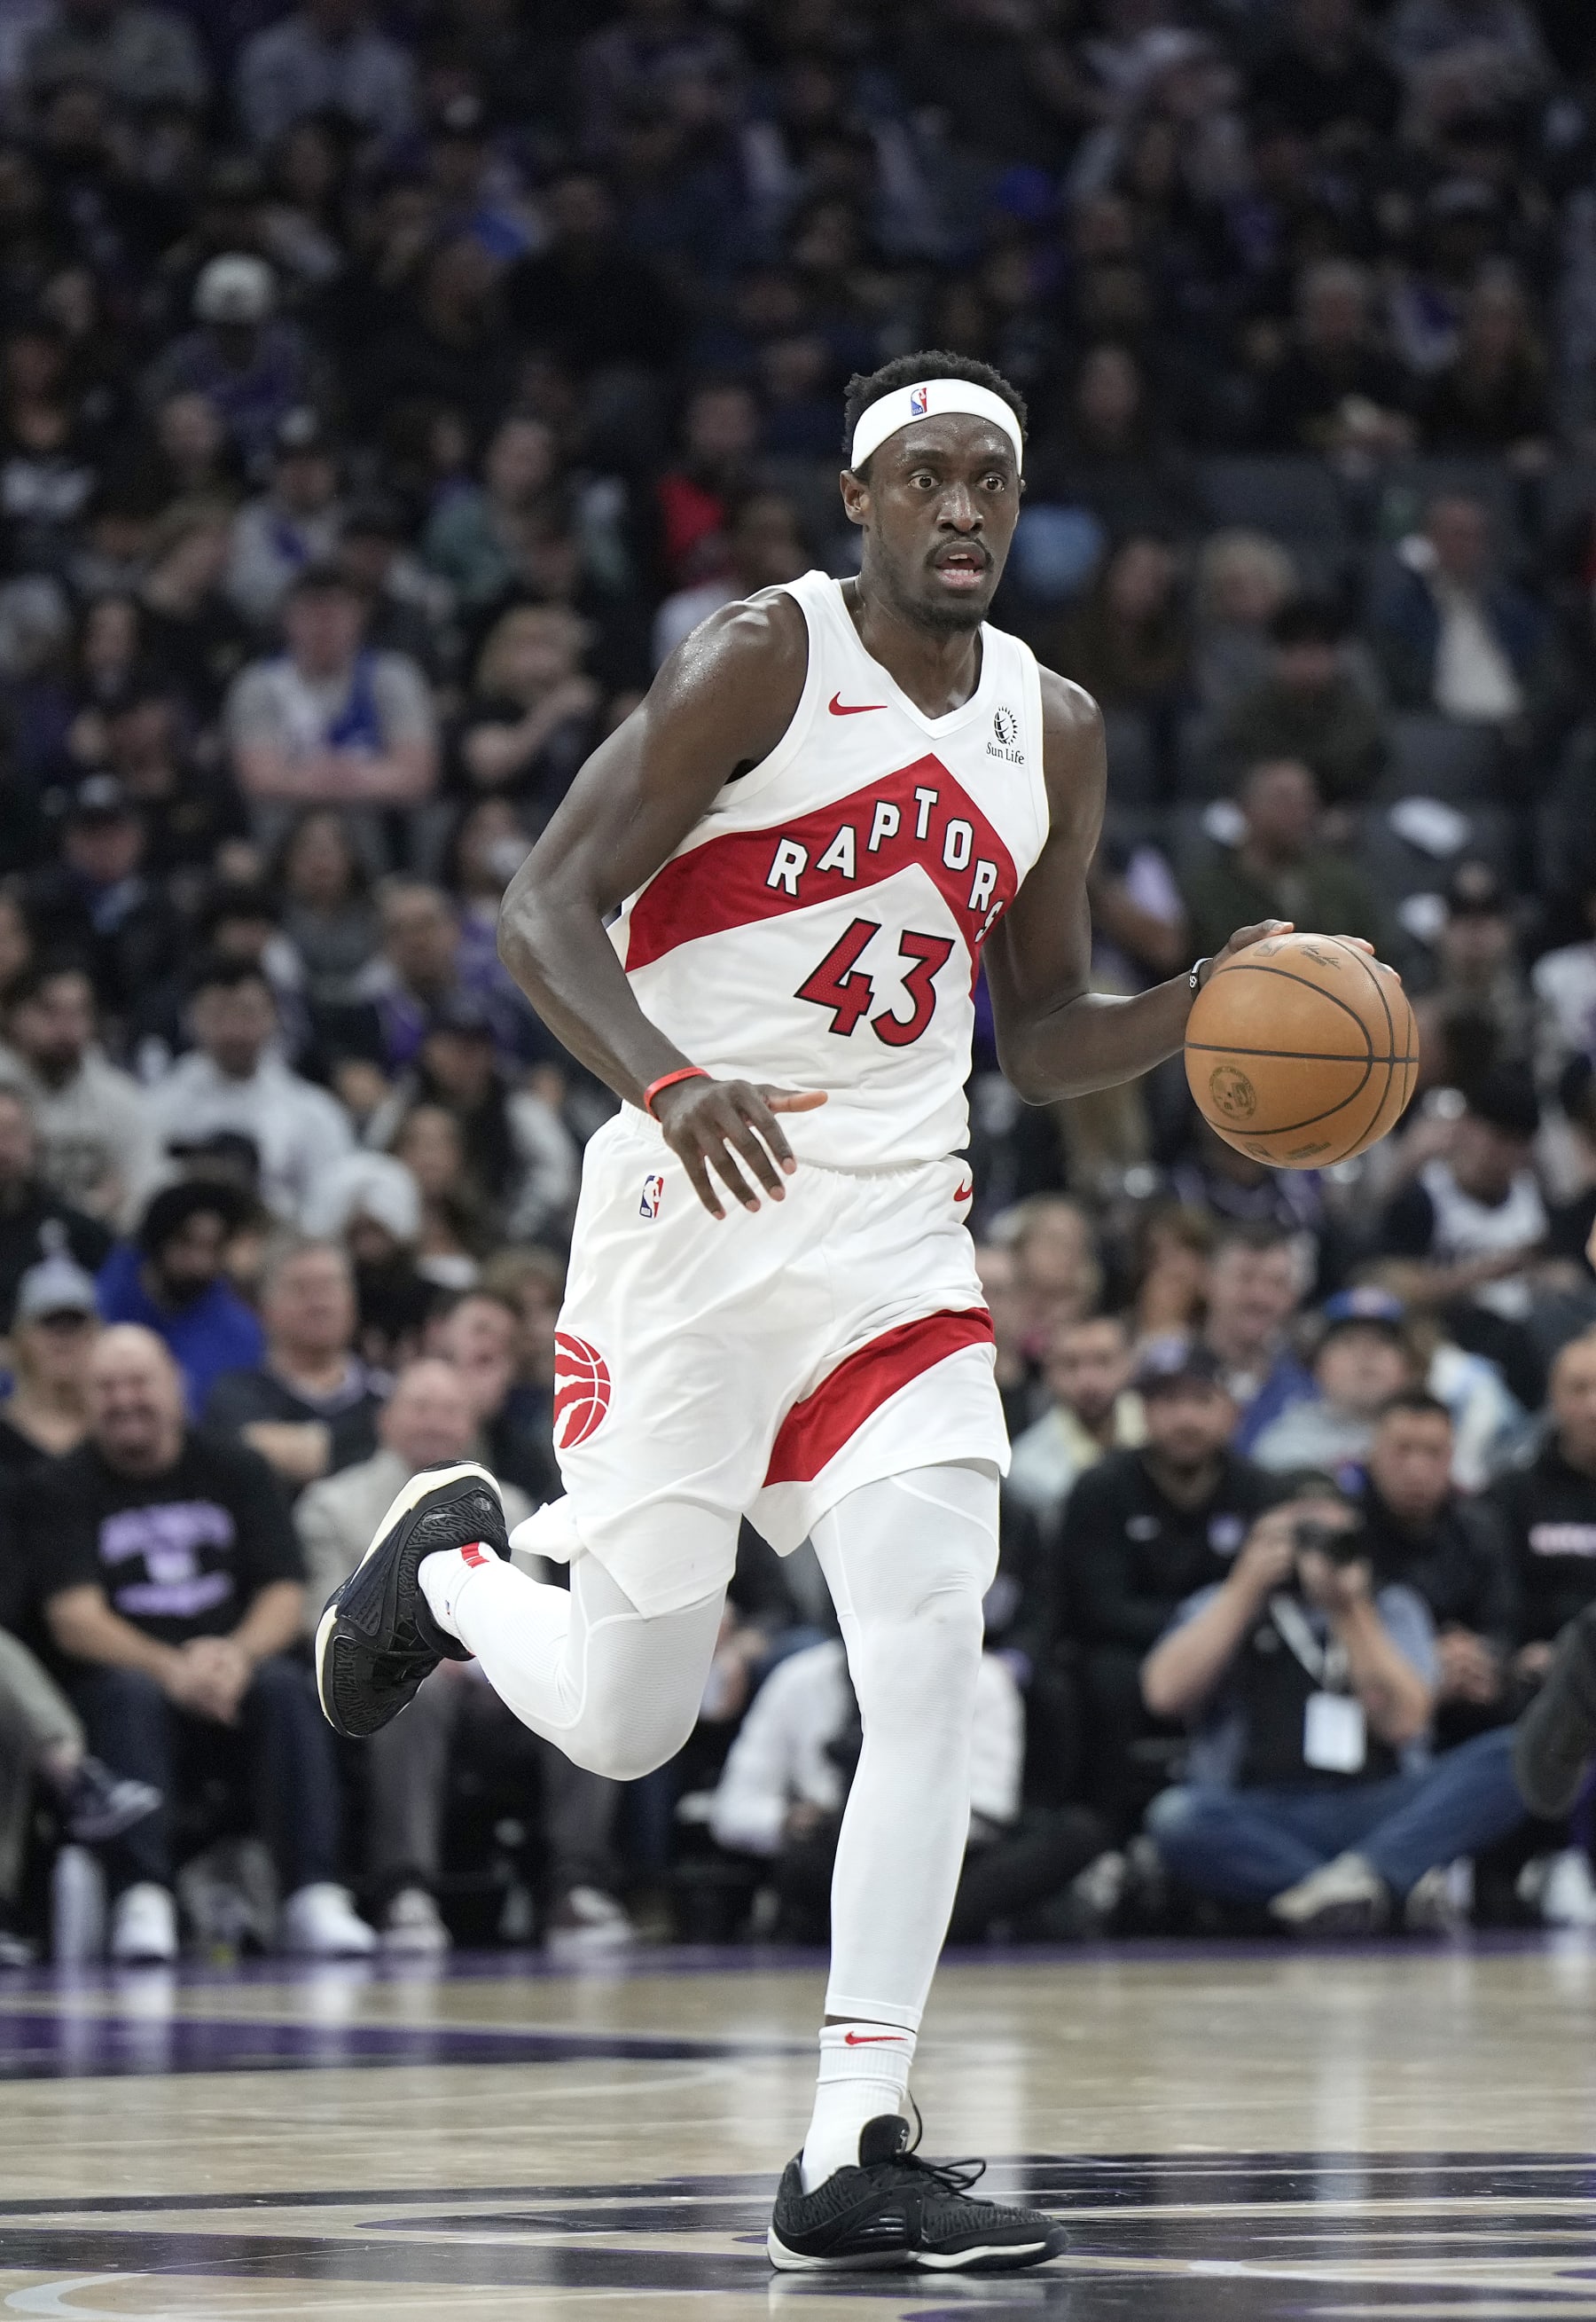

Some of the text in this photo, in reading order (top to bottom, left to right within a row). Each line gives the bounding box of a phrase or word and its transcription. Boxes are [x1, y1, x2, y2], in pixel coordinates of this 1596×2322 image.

[985, 741, 1025, 765] Sun Life
[794, 917, 955, 1047] 43
